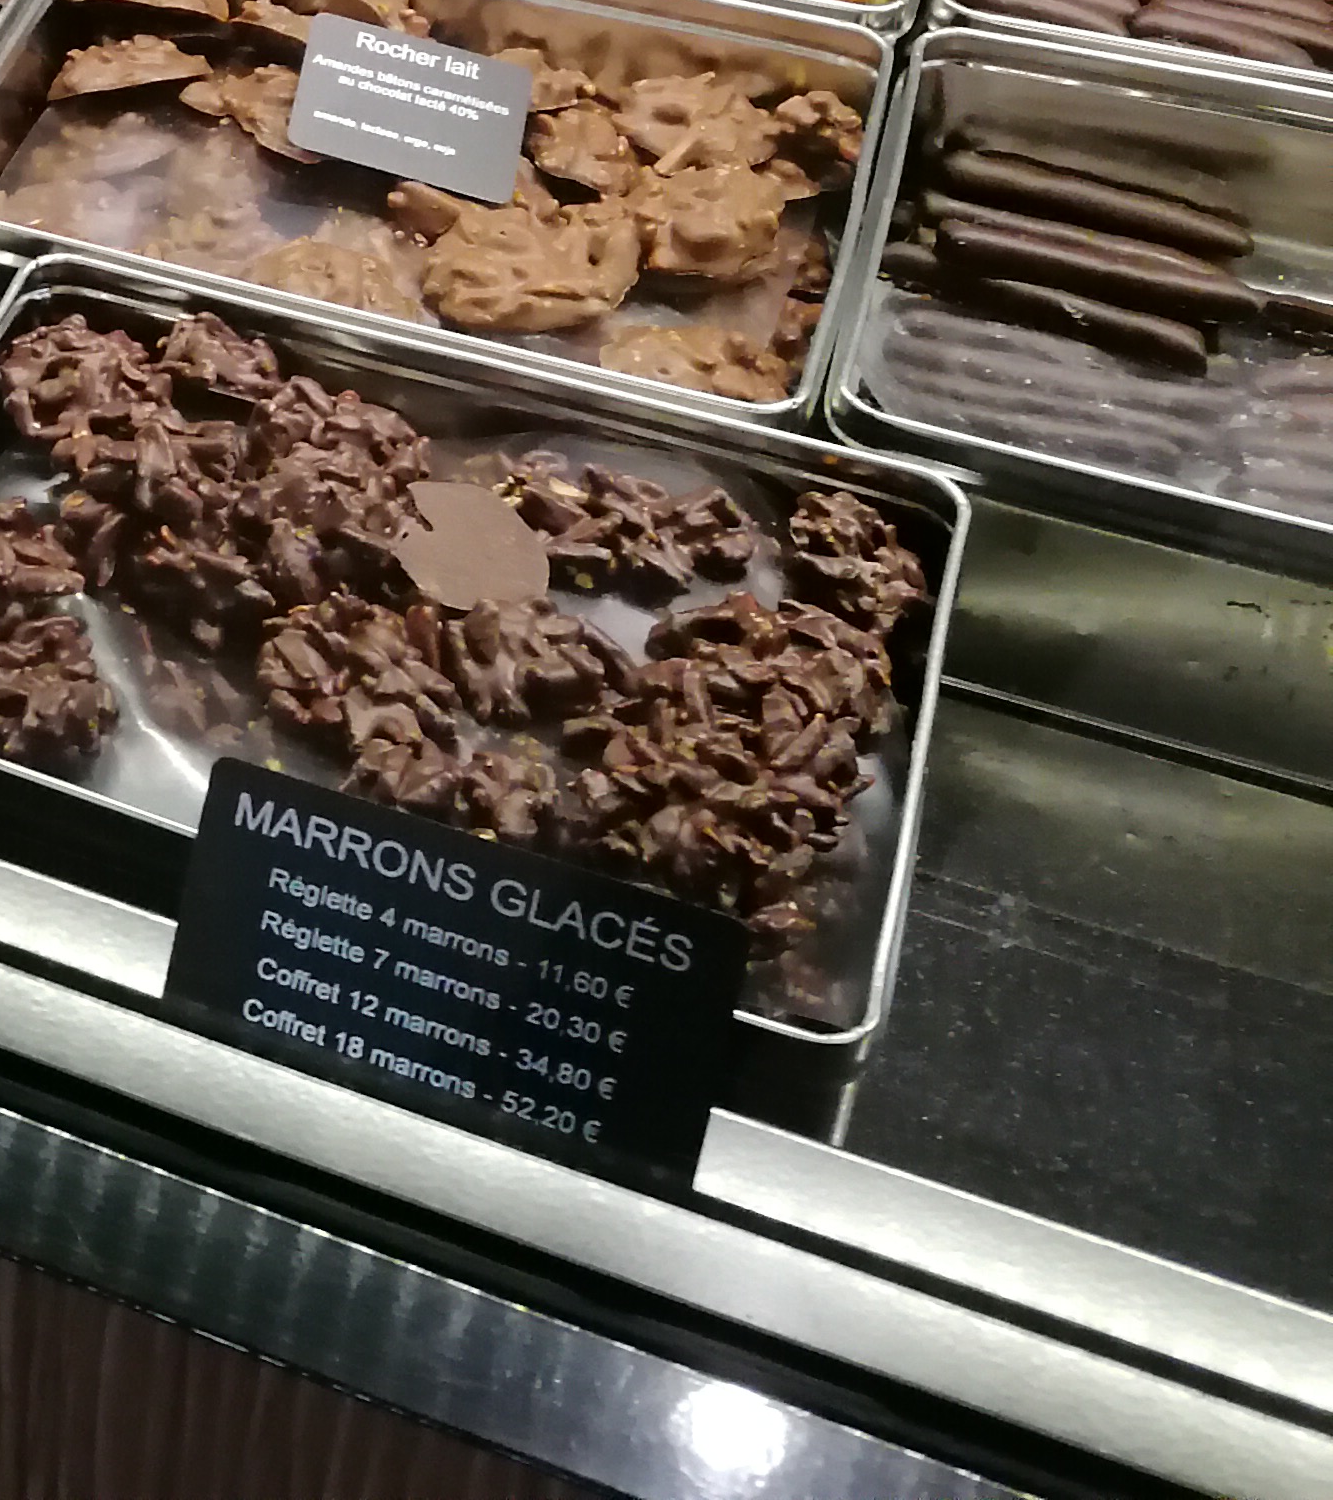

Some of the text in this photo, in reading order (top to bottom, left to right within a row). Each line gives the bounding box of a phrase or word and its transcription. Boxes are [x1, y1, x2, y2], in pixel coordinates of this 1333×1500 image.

[312, 53, 510, 116] Amandes bâtons caramélisées
[338, 75, 479, 121] au chocolat lacté 40%
[356, 31, 480, 80] Rocher lait
[234, 792, 694, 972] MARRONS GLACÉS
[269, 867, 372, 921] Réglette
[380, 908, 396, 928] 4
[403, 916, 509, 966] marrons
[538, 959, 608, 999] 11,60
[615, 985, 634, 1008] €
[257, 957, 340, 1004] Coffret
[349, 989, 377, 1018] 12
[385, 1005, 491, 1057] marrons
[516, 1048, 591, 1092] 34,80
[597, 1077, 618, 1100] €
[261, 910, 364, 964] Réglette
[374, 949, 390, 970] 7
[394, 959, 500, 1011] marrons
[526, 1002, 601, 1045] 20,30
[608, 1030, 628, 1053] €
[242, 998, 326, 1047] Coffret
[335, 1031, 363, 1059] 18
[370, 1047, 476, 1100] marrons
[501, 1091, 576, 1134] 52,20
[582, 1120, 603, 1143] €
